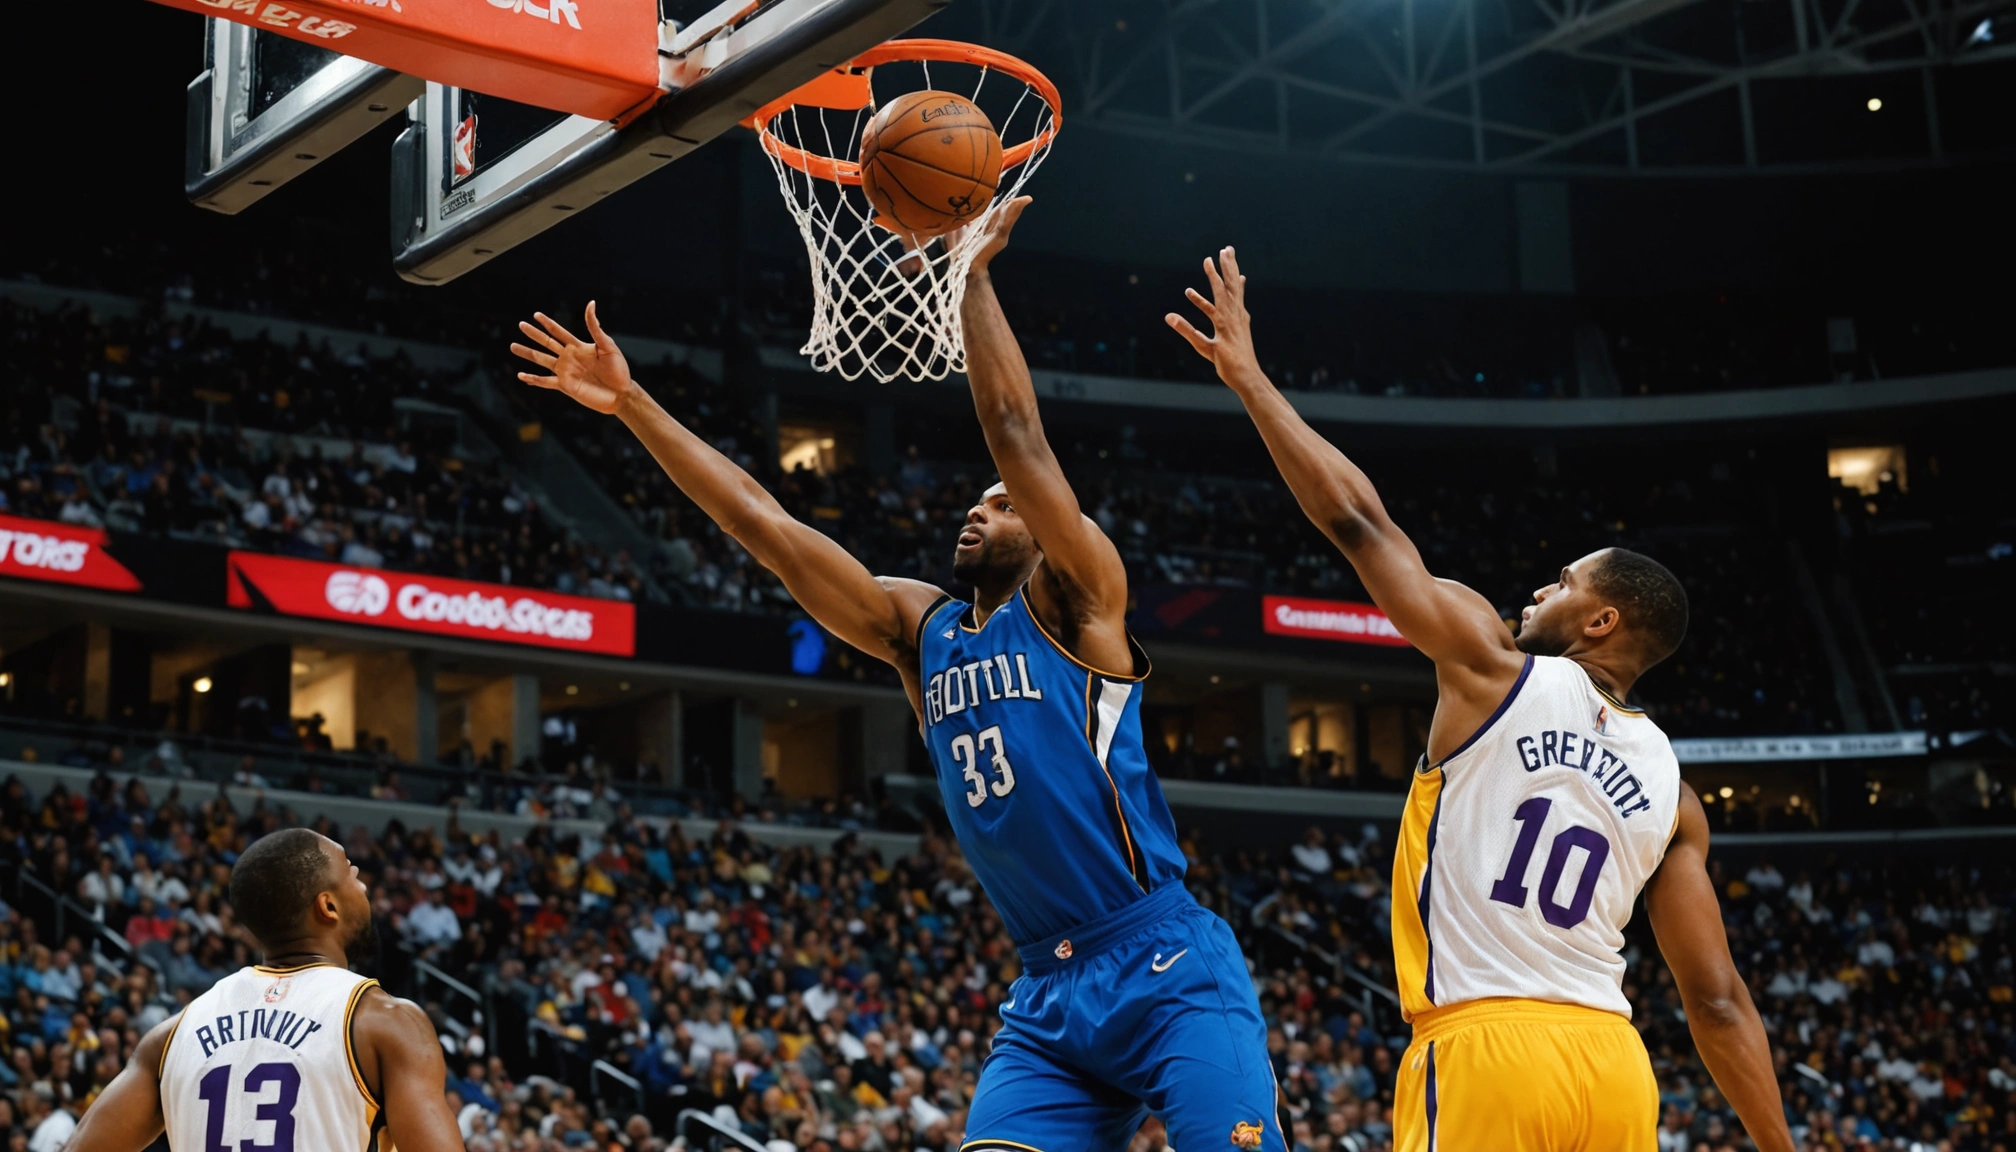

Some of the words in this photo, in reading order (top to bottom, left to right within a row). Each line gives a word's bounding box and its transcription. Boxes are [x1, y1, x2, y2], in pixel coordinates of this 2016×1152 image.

[951, 725, 1016, 808] 33
[1489, 796, 1610, 929] 10
[199, 1062, 301, 1152] 13
